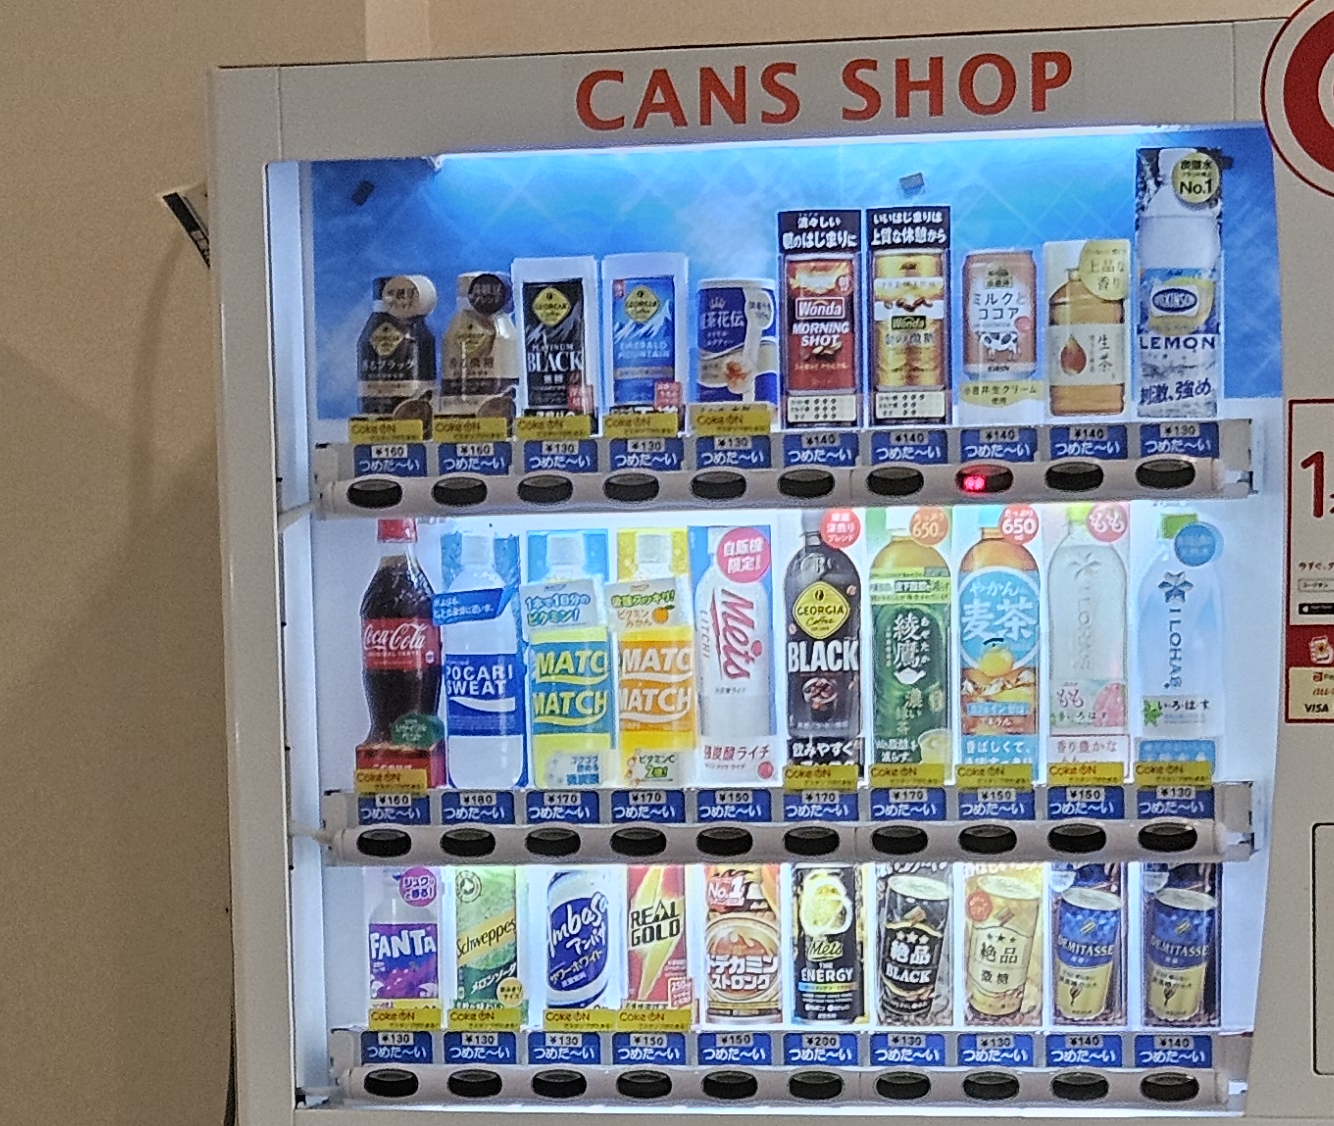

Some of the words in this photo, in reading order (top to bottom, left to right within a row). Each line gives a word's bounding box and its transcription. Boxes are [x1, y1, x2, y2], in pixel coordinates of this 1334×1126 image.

[576, 61, 800, 132] CANS
[842, 51, 1071, 121] SHOP
[1179, 179, 1213, 195] No.1
[798, 303, 842, 317] Wonda
[979, 308, 1020, 321] ココア
[793, 322, 850, 334] MORNING
[801, 335, 841, 347] SHOT
[1139, 335, 1216, 351] LEMON
[527, 351, 583, 372] BLACK
[895, 432, 925, 442] ¥140
[1074, 428, 1104, 439] ¥140
[912, 523, 939, 538] 650
[1002, 520, 1037, 535] 650
[797, 605, 844, 616] GEORGIA
[963, 600, 1037, 641] 麦茶
[788, 640, 859, 673] BLACK
[1304, 703, 1329, 713] VISA
[793, 740, 854, 758] 飲みやすく
[547, 794, 577, 804] ¥170
[632, 792, 661, 802] ¥170
[631, 900, 680, 929] REAL
[456, 918, 517, 958] Schweppes
[631, 917, 681, 947] GOLD
[370, 929, 436, 960] FANTA
[980, 942, 1018, 964] 絶品
[802, 968, 854, 982] ENERGY
[886, 963, 932, 983] BLACK
[710, 974, 771, 991] ストロング
[382, 1035, 410, 1044] ¥130
[466, 1035, 495, 1045] ¥130
[549, 1036, 578, 1046] ¥130
[1070, 1036, 1100, 1046] ¥140
[1160, 1038, 1190, 1048] ¥140
